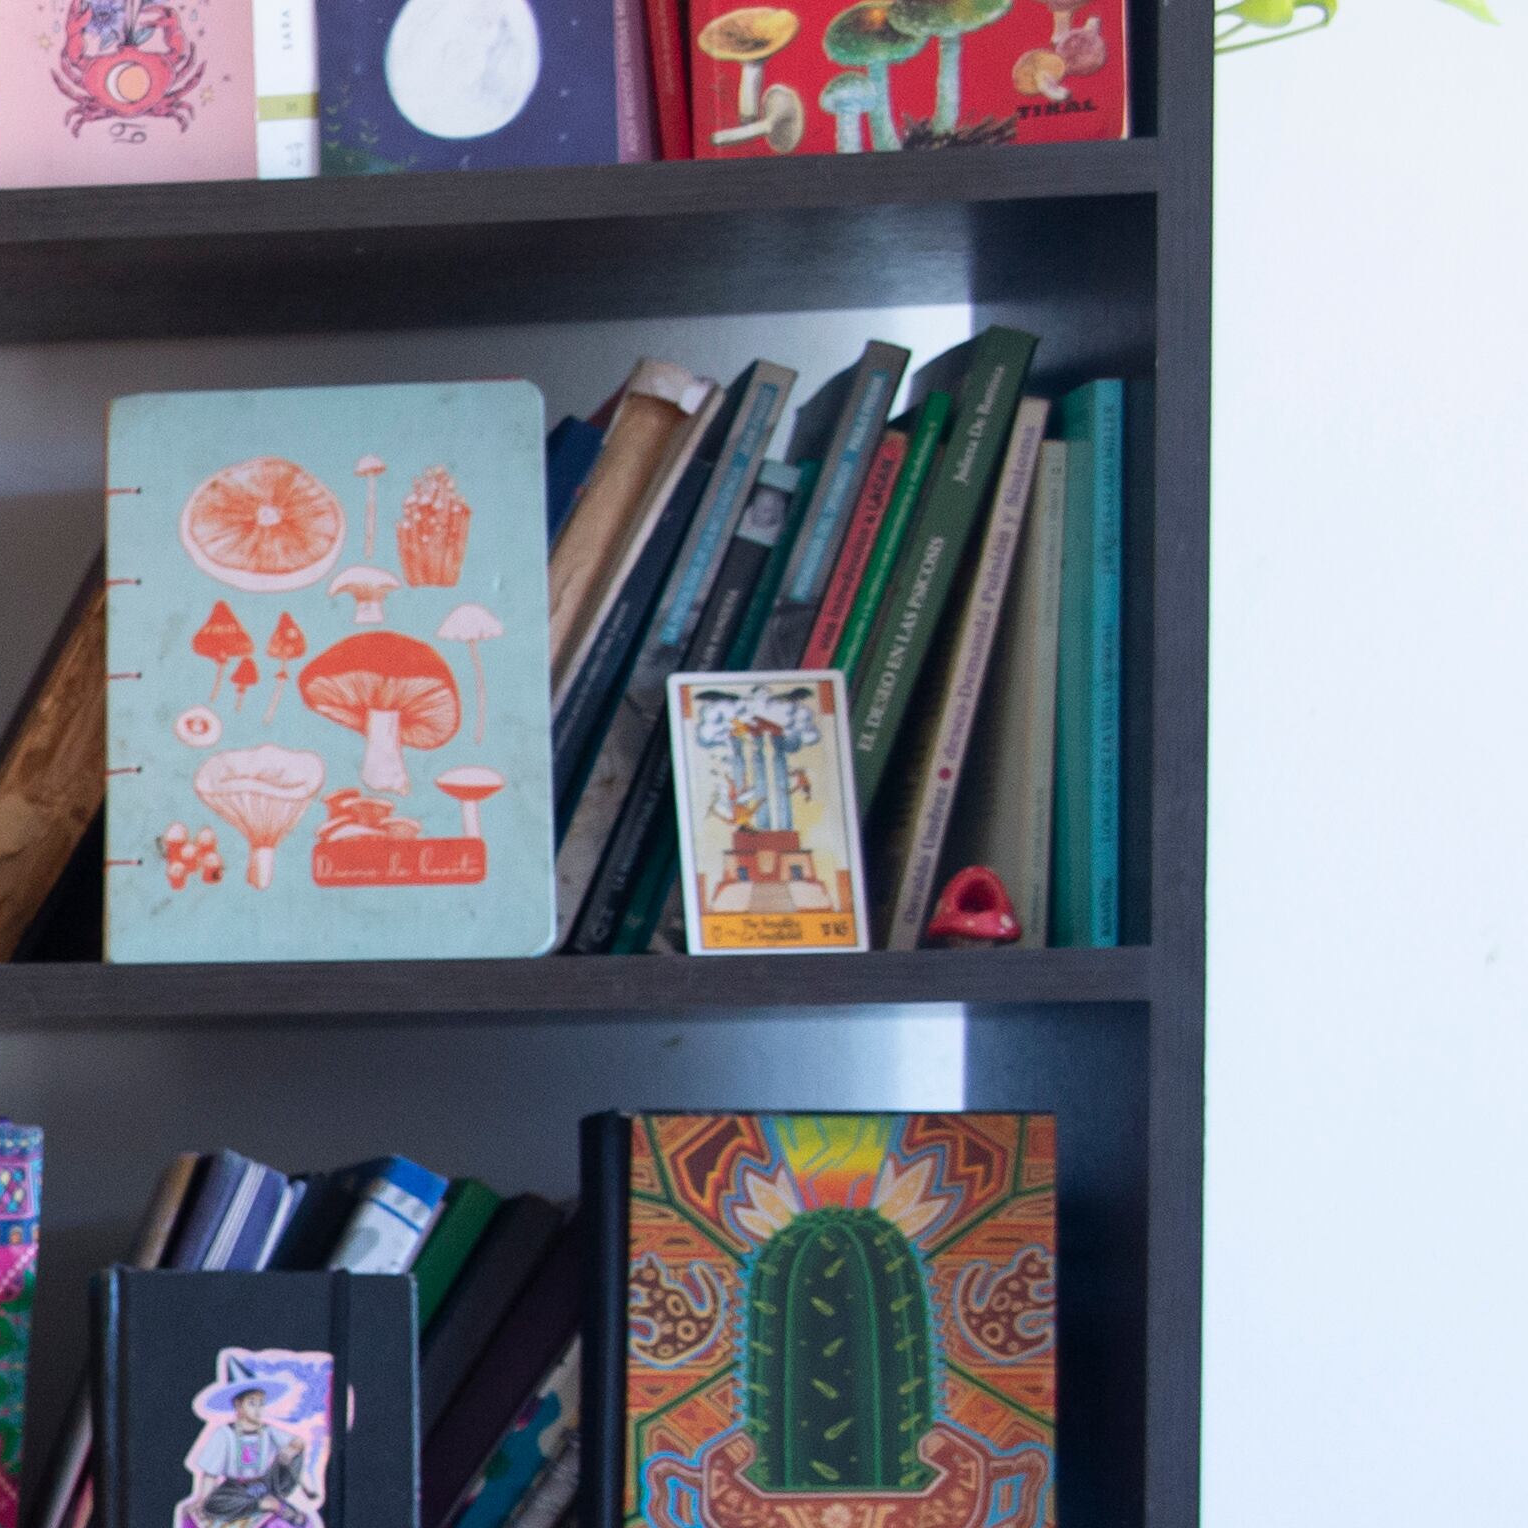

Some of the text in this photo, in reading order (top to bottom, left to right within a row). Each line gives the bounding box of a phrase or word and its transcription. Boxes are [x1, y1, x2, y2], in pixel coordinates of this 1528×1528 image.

[1016, 98, 1098, 119] TIKAL
[966, 414, 988, 439] De
[949, 437, 985, 486] Julieta
[978, 528, 1013, 605] Pulsión
[855, 533, 946, 753] EL DESEO EN LAS PSICOSIS
